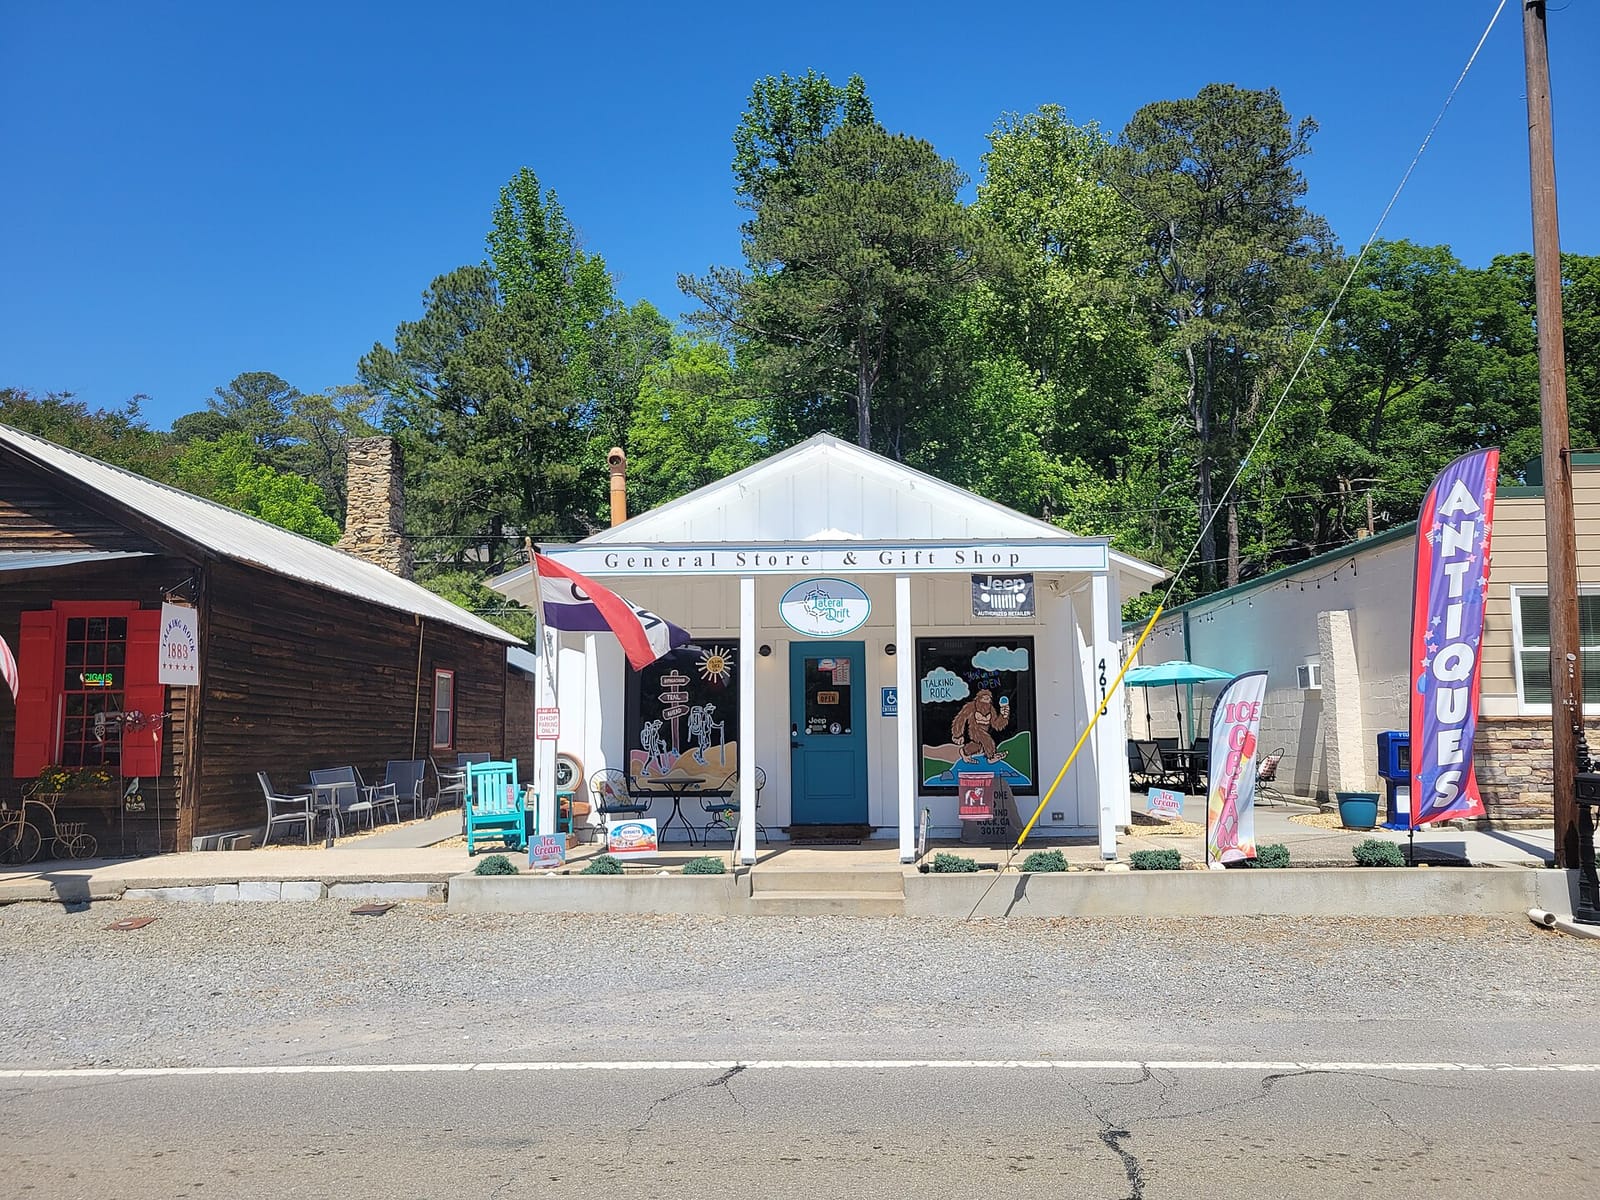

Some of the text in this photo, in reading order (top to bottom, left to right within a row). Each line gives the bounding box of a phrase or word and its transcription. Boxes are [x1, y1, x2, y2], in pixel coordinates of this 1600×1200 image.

[604, 550, 1019, 568] General Store & Gift Shop
[980, 575, 1026, 593] Jeep
[811, 595, 844, 611] Lateral
[825, 607, 851, 624] Drift
[182, 624, 196, 653] ROCK
[1431, 478, 1480, 809] ANTIQUES
[84, 673, 113, 681] CIGARS
[924, 678, 954, 688] TALKING
[819, 694, 836, 703] OPEN
[929, 687, 951, 699] ROCK
[1224, 701, 1261, 724] ICE
[808, 716, 827, 725] Jeep
[1216, 724, 1249, 849] CREAM
[1160, 791, 1173, 800] Ice
[1152, 798, 1180, 809] Cream
[980, 826, 1006, 835] 30175
[541, 836, 555, 847] Ice
[534, 845, 562, 857] Cream
